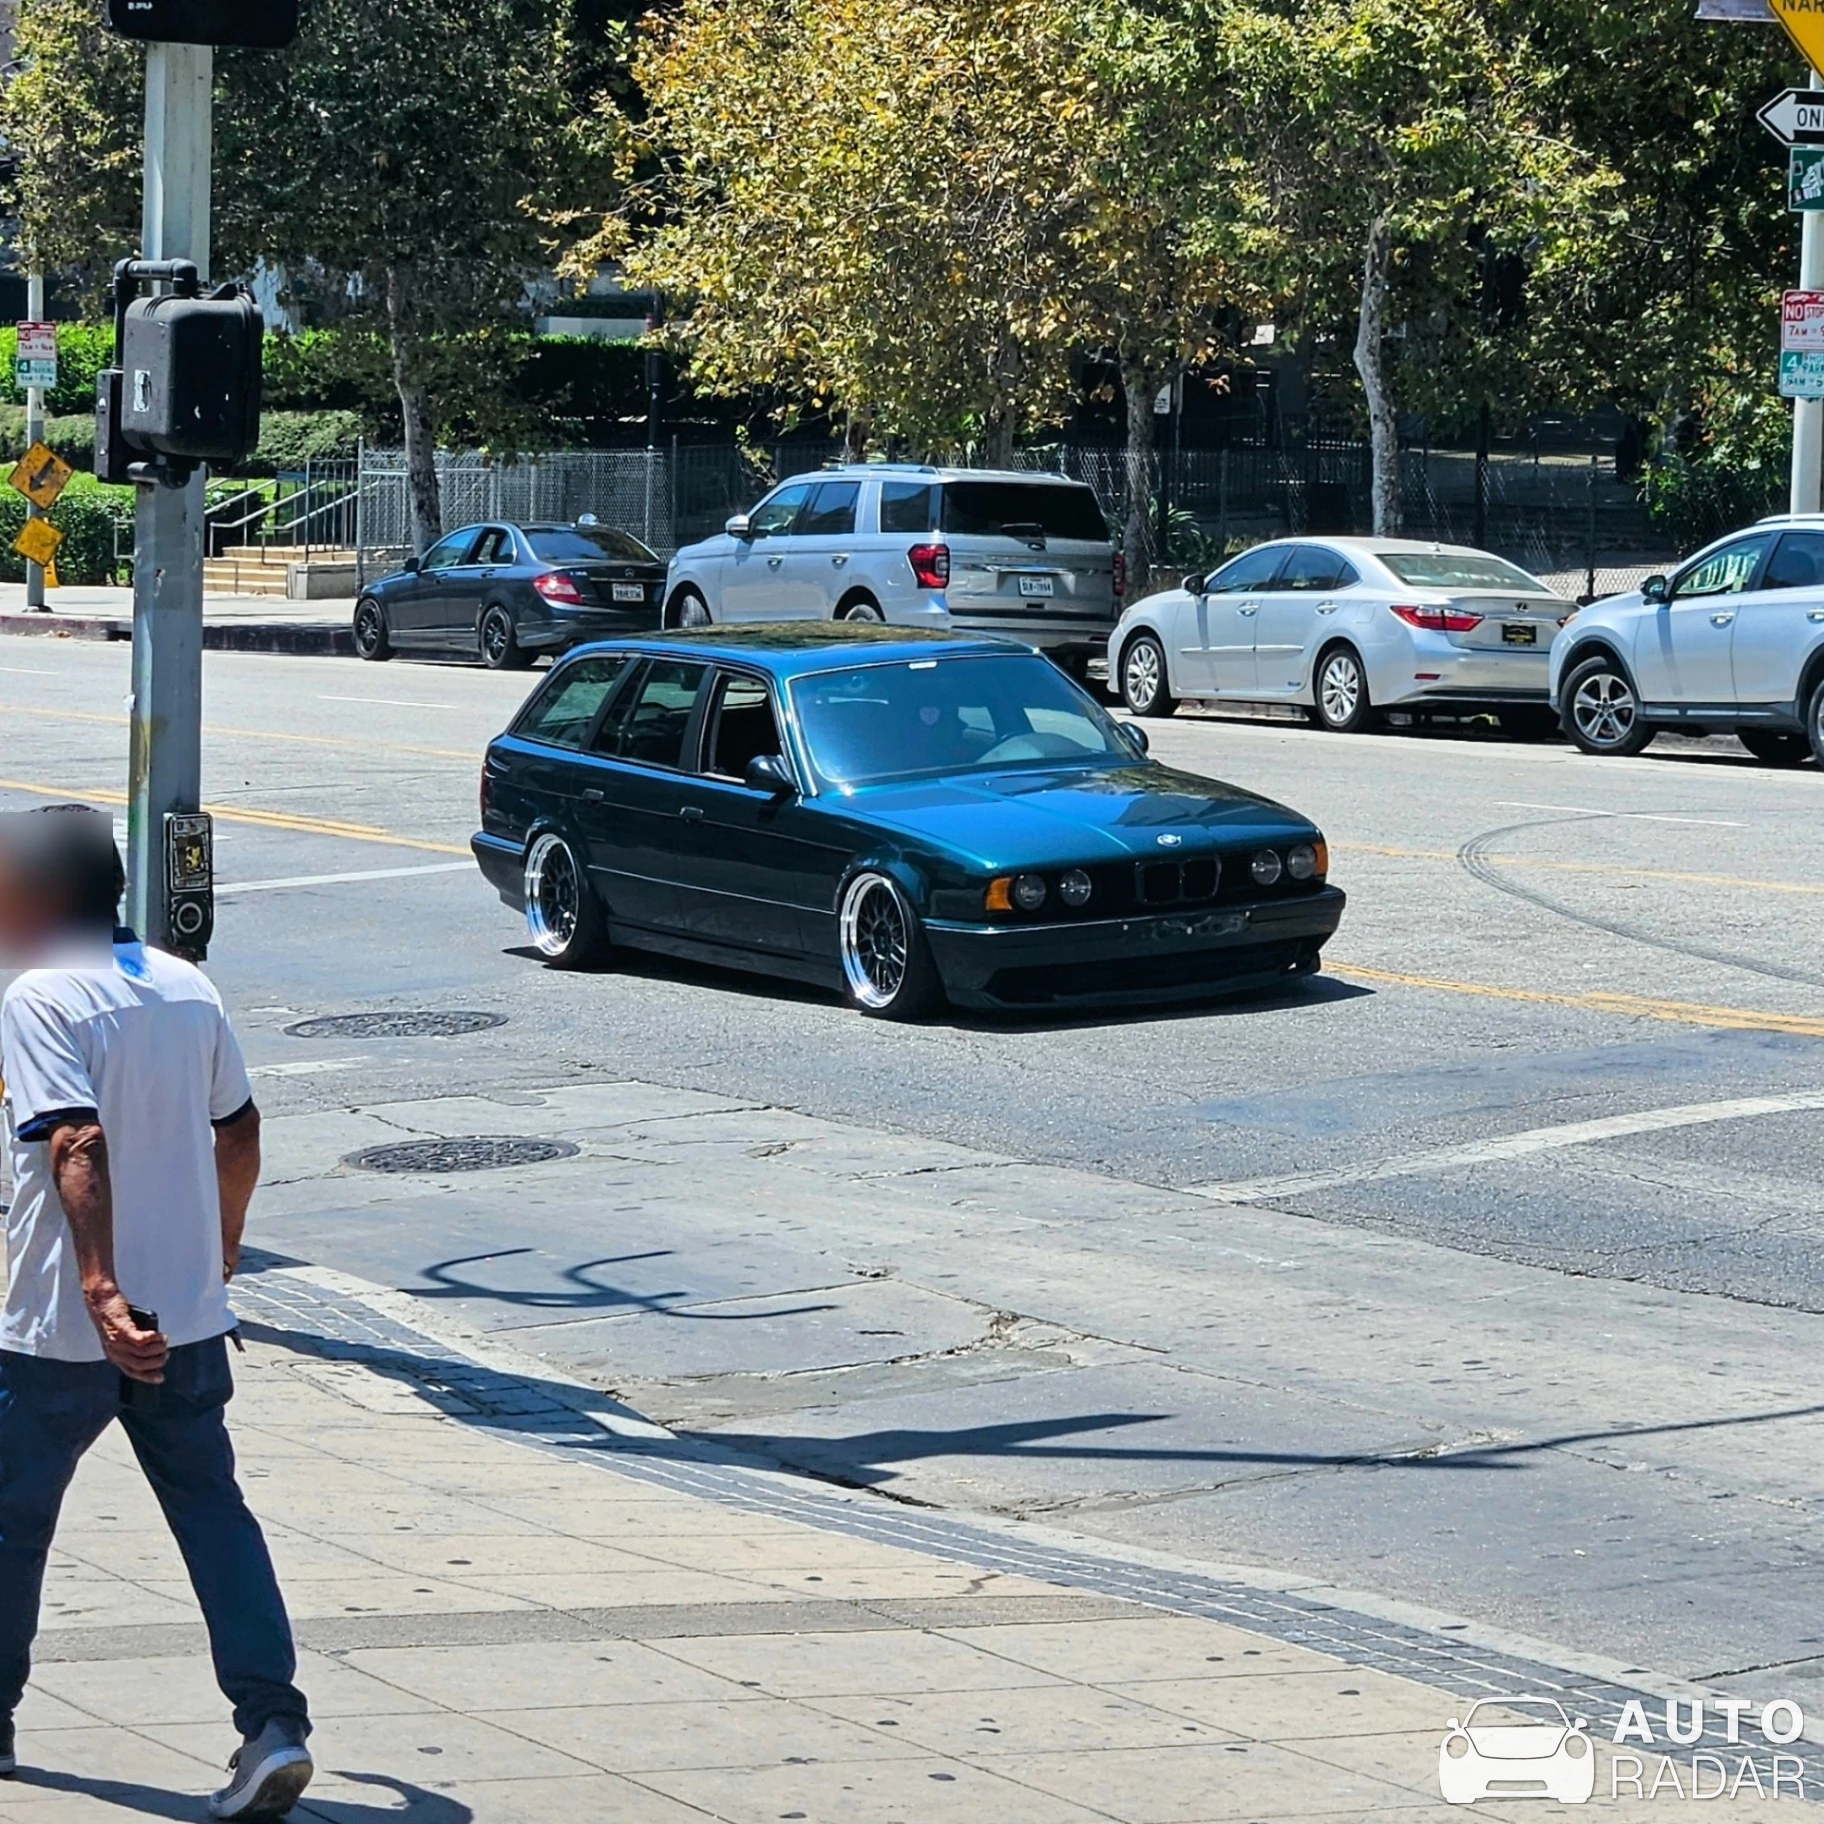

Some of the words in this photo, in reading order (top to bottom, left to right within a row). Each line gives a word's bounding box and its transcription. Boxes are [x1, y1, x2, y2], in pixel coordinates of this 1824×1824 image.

[1797, 107, 1824, 127] ON
[1785, 303, 1803, 320] NO
[20, 361, 28, 371] 4
[1786, 354, 1798, 371] 4
